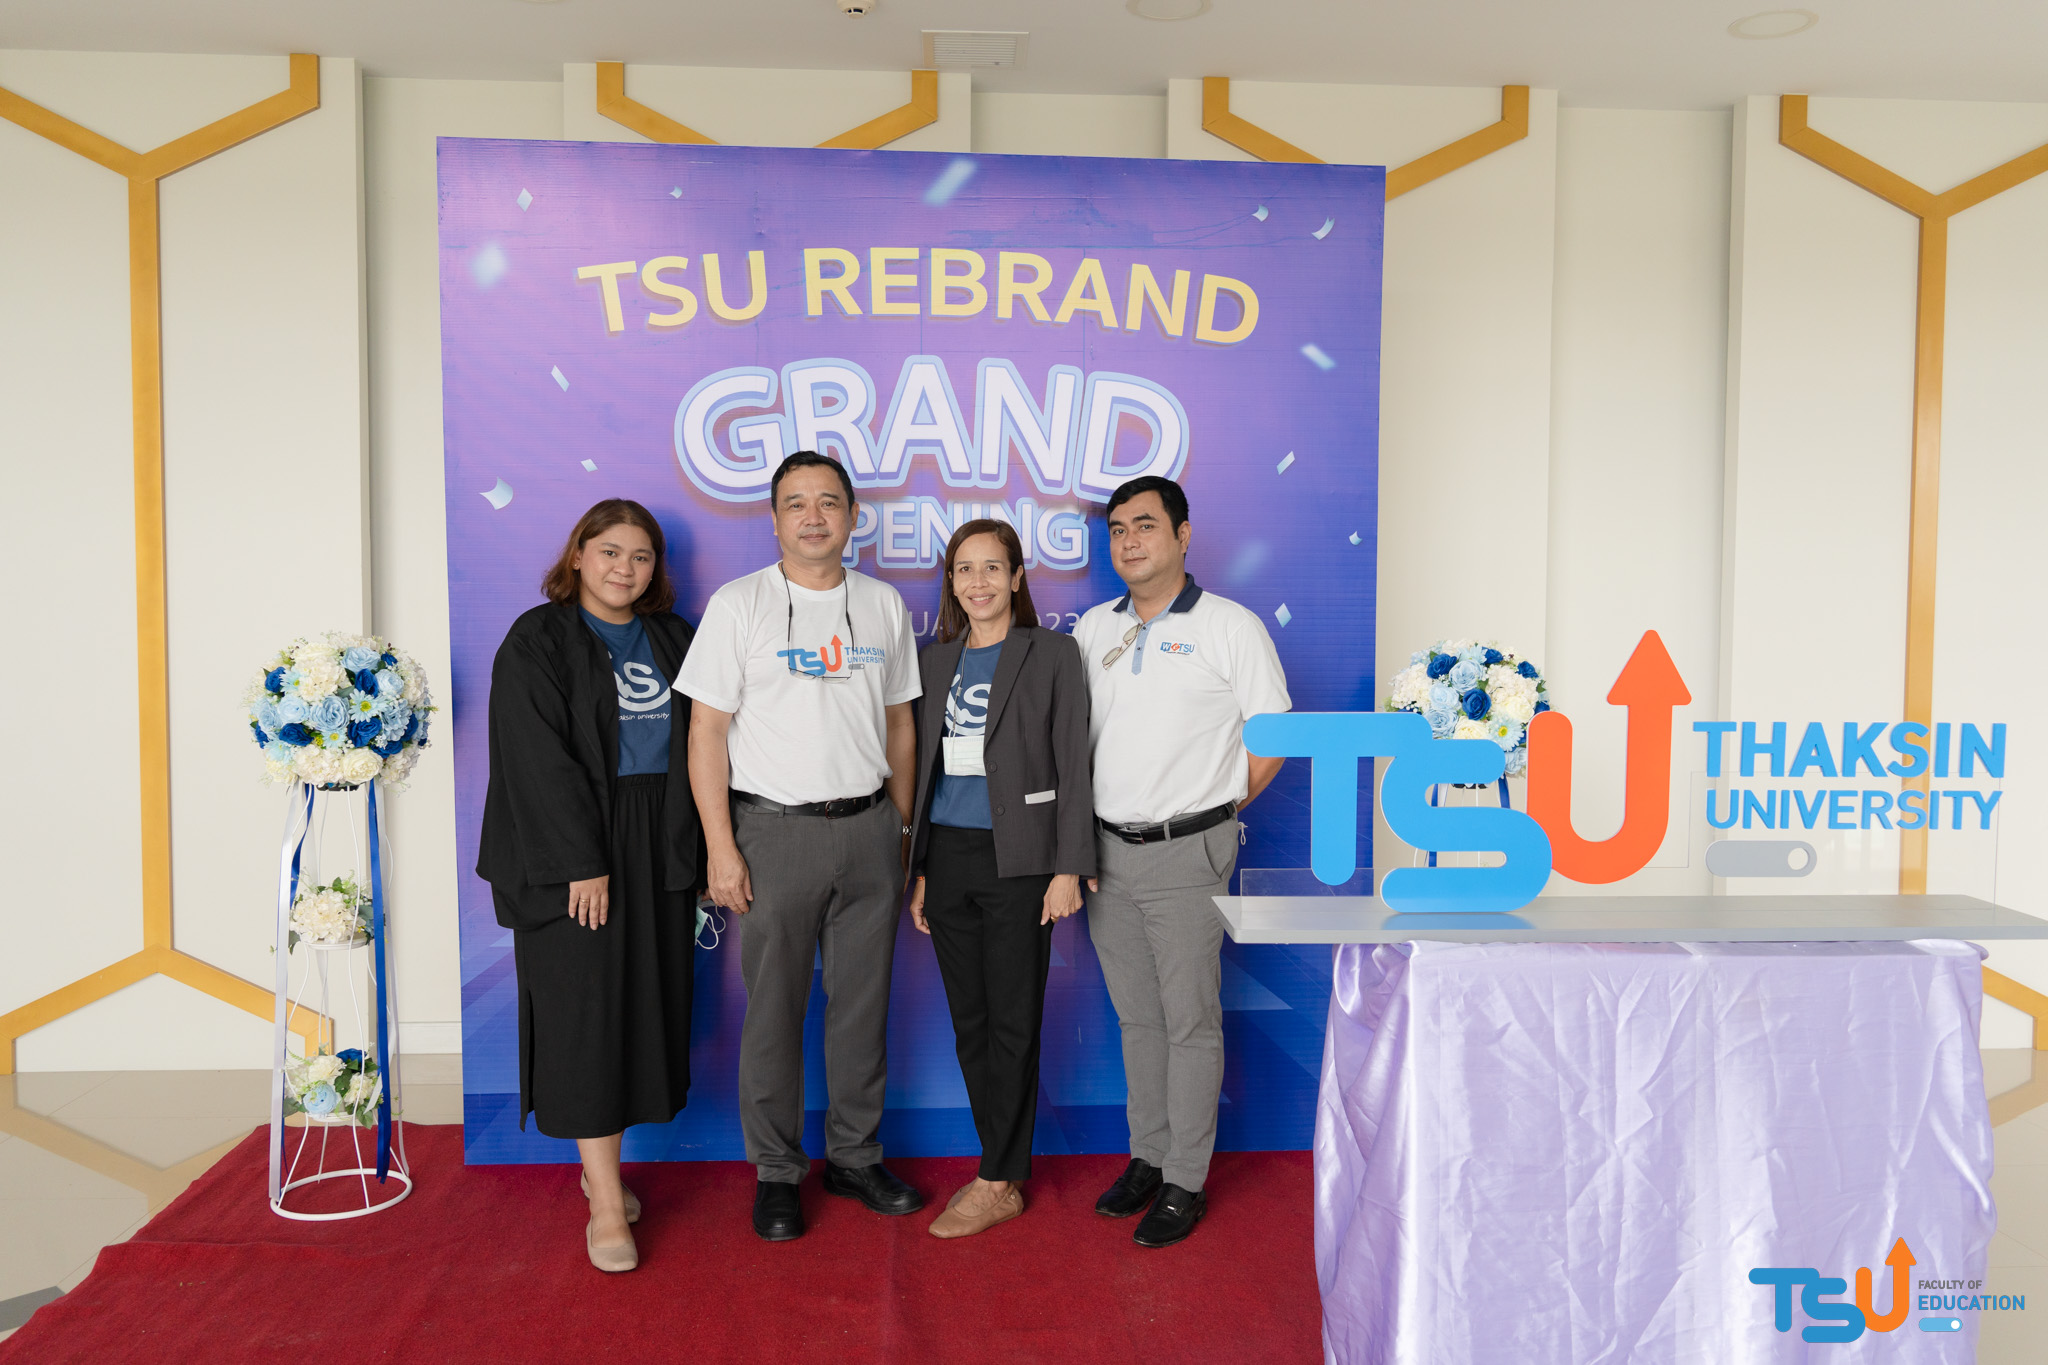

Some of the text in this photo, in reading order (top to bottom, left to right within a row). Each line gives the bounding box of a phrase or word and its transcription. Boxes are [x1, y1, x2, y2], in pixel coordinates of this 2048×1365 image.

[576, 246, 1261, 345] TSU REBRAND
[674, 355, 1190, 505] GRAND
[776, 634, 843, 677] TSU
[844, 646, 886, 658] THAKSIN
[1242, 629, 1692, 913] TSU
[1693, 721, 2007, 779] THAKSIN
[1705, 789, 2004, 830] UNIVERSITY
